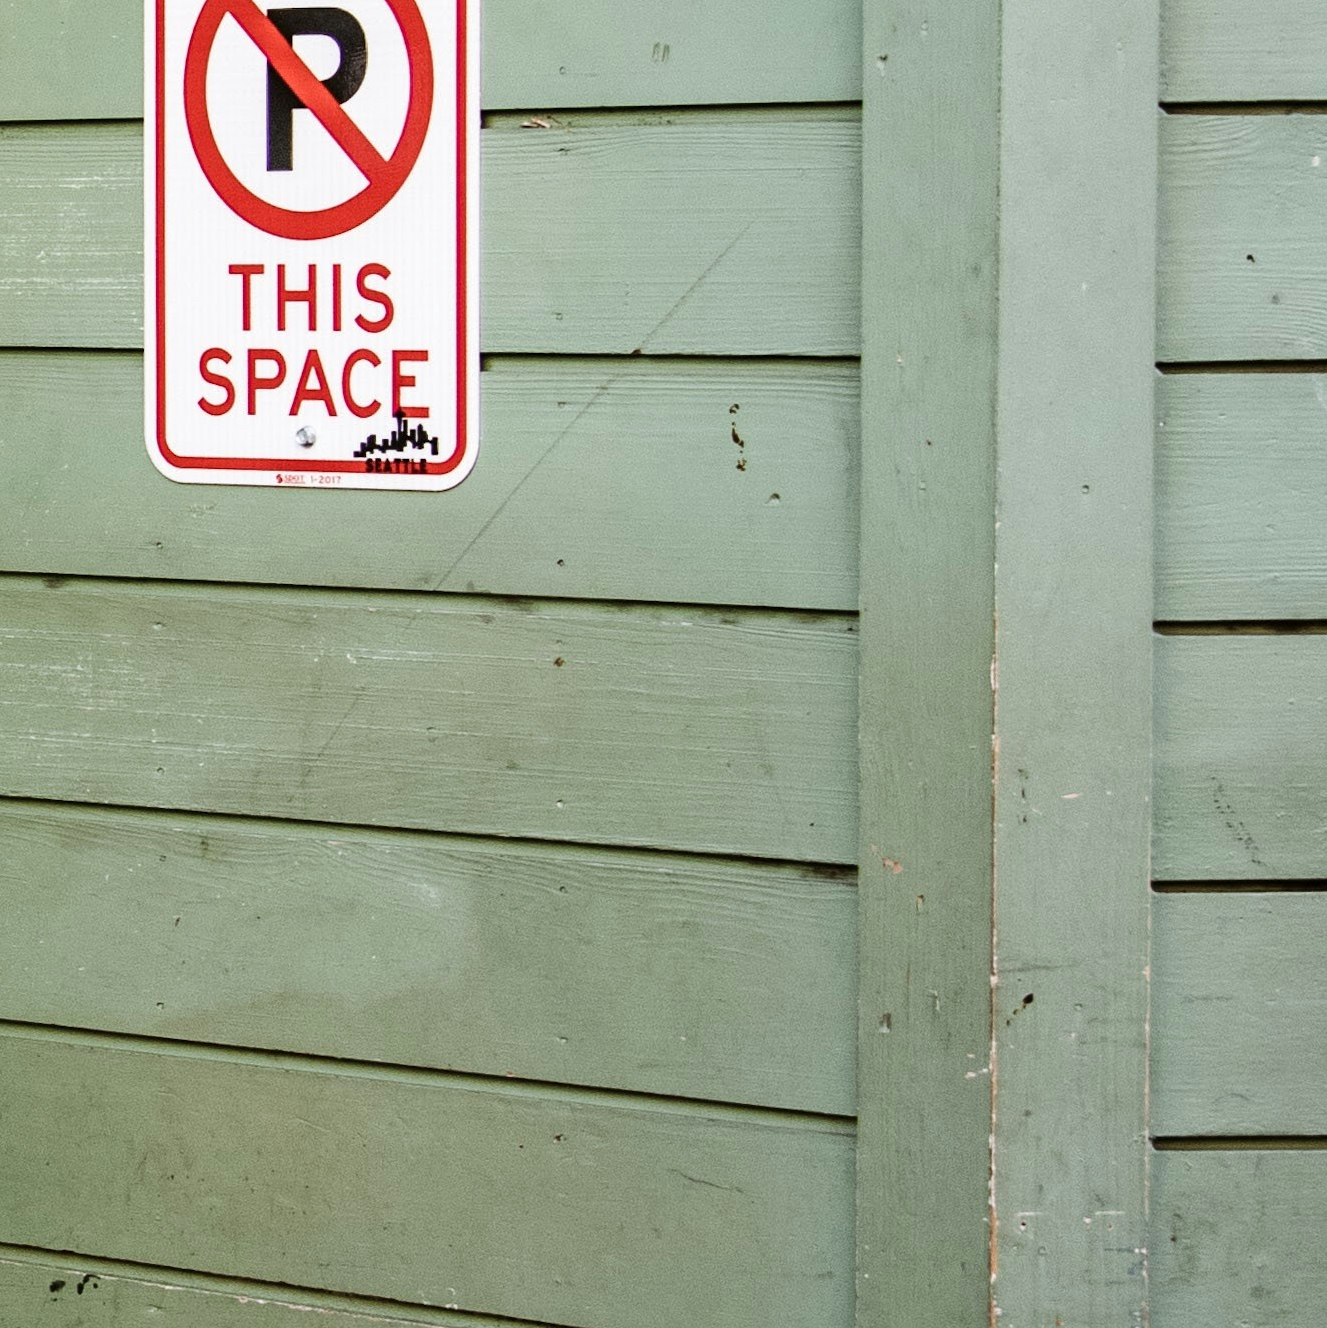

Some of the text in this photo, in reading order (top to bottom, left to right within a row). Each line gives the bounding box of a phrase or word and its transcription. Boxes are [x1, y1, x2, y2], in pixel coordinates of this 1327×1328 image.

[228, 262, 395, 333] THIS
[197, 348, 430, 419] SPACE
[365, 457, 428, 474] SEATTLE
